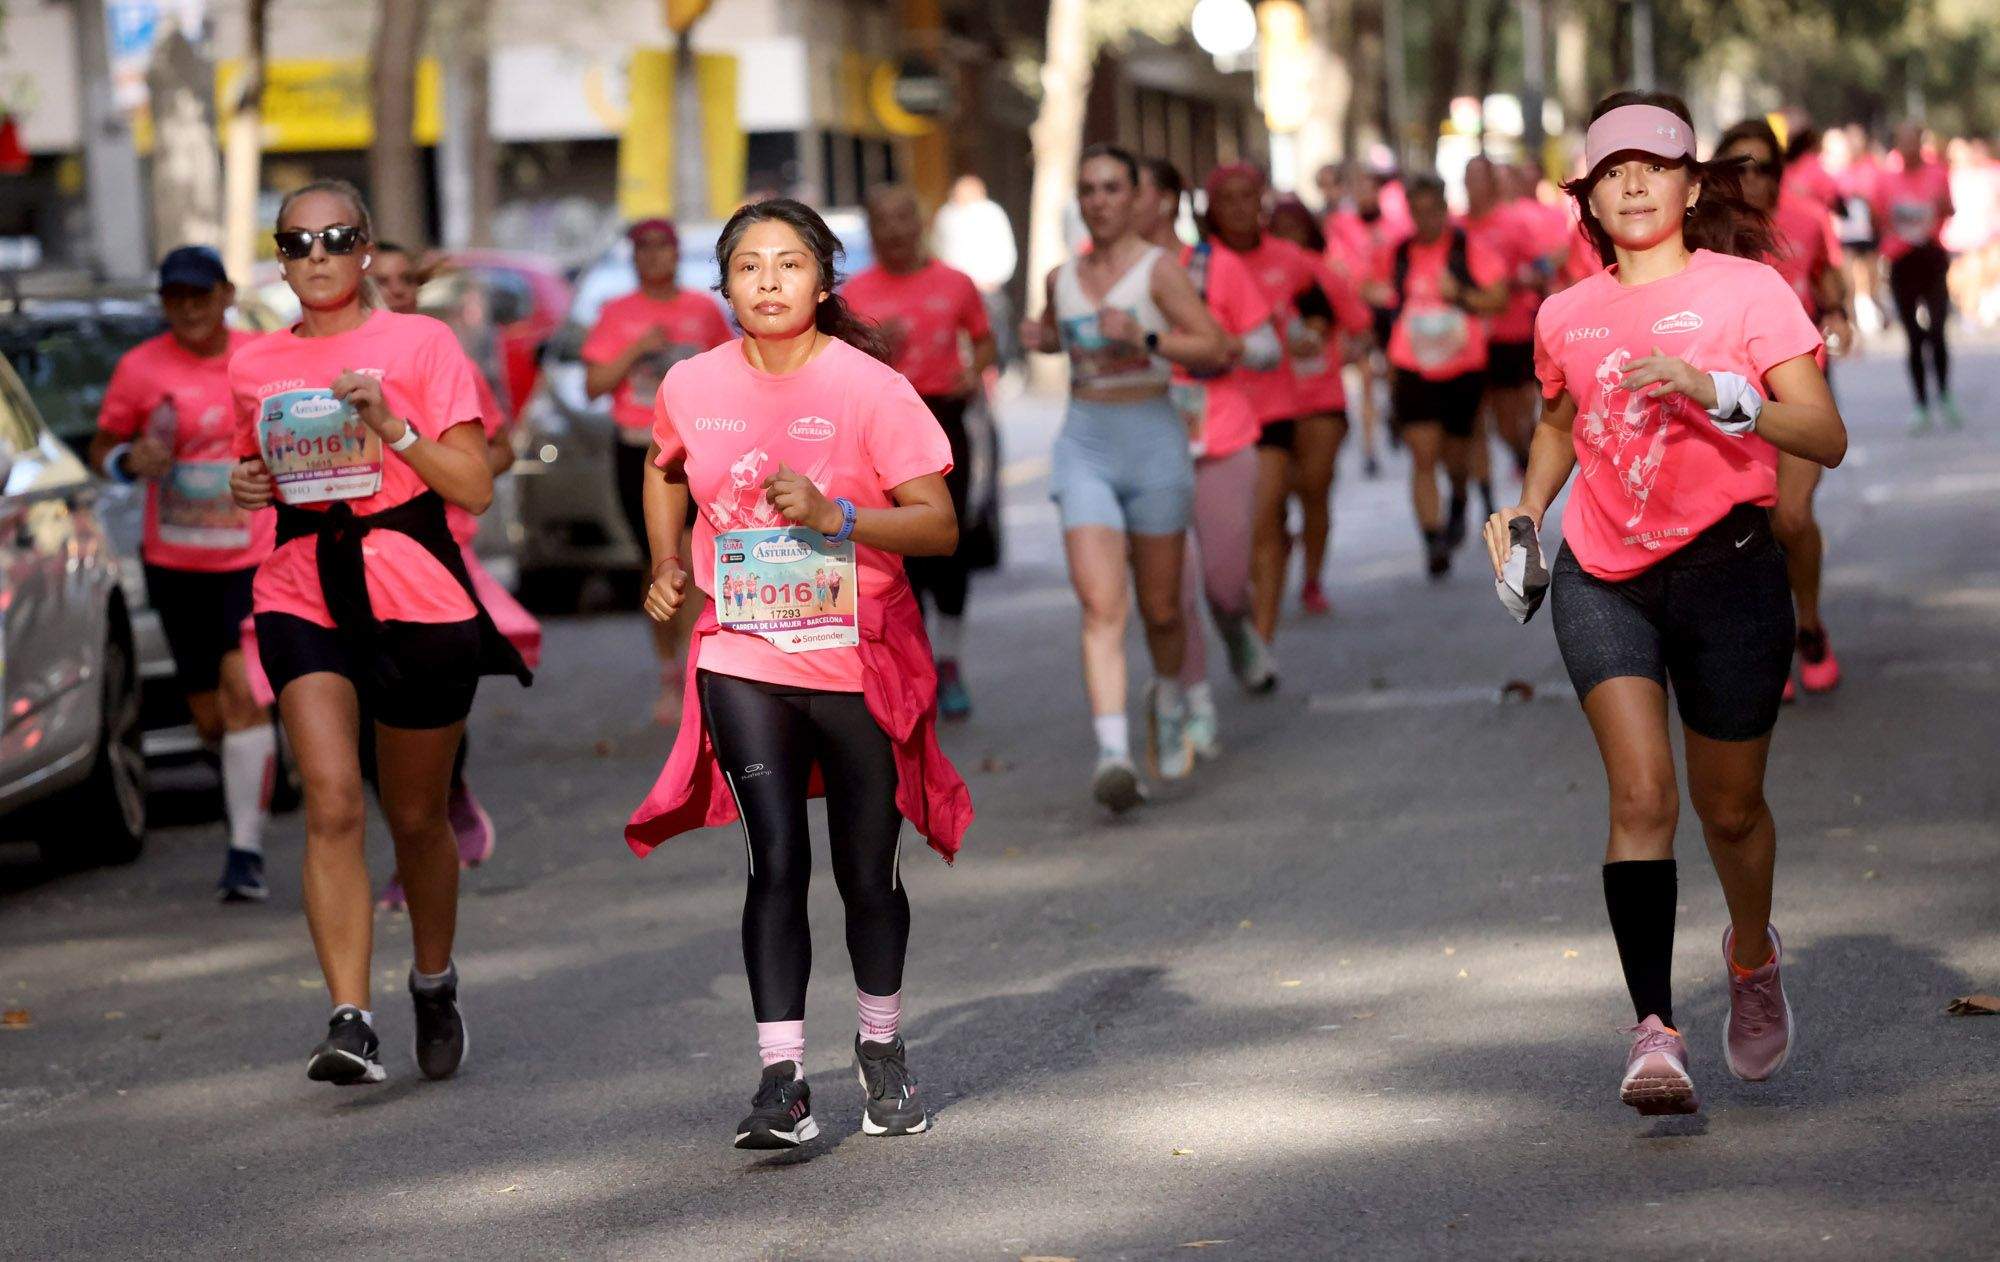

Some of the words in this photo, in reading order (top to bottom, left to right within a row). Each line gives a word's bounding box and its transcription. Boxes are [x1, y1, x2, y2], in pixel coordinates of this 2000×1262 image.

[695, 417, 747, 433] OYSHO
[297, 435, 342, 456] 016
[757, 546, 808, 558] ASTURIANA
[760, 582, 813, 605] 016
[770, 608, 801, 619] 17293
[732, 623, 759, 631] CARRERA
[780, 620, 801, 628] MUJER
[807, 617, 843, 626] BARCELONA
[803, 632, 844, 643] Santander
